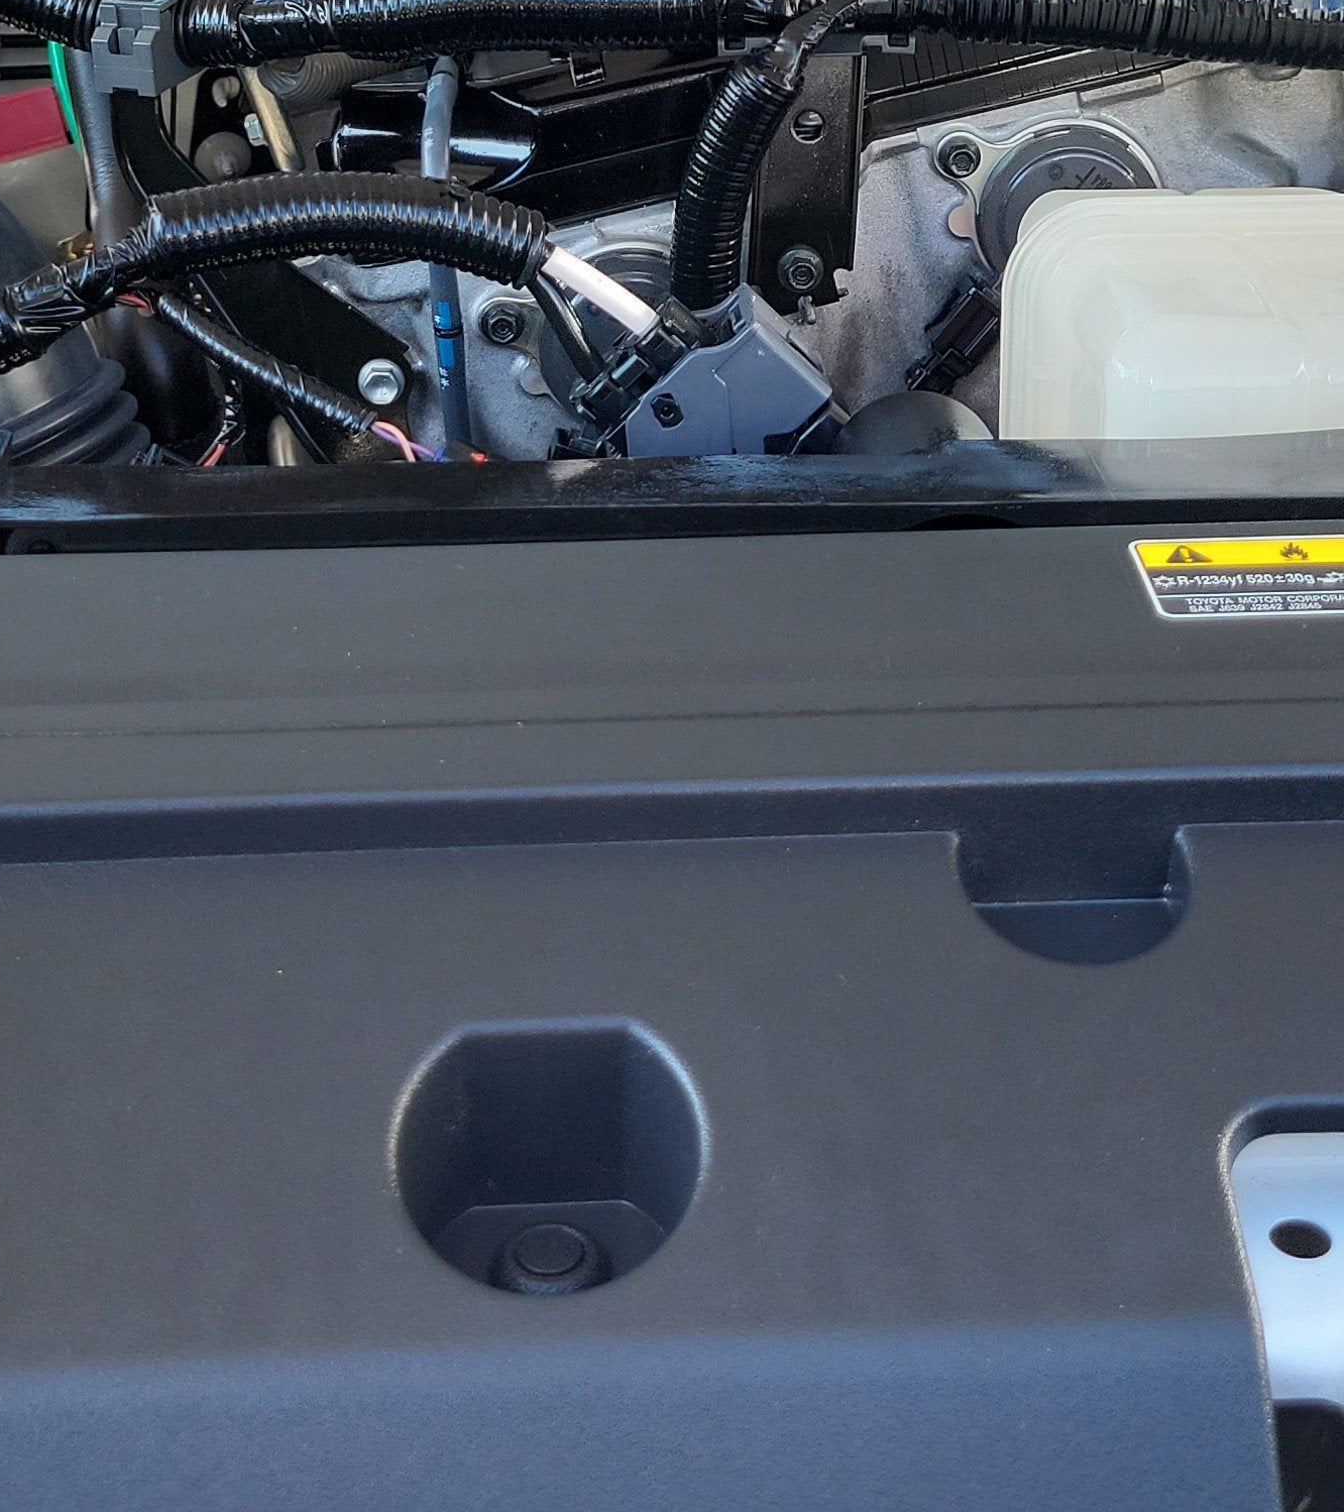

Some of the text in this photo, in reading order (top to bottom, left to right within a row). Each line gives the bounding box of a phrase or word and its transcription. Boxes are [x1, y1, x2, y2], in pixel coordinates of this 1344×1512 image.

[1176, 573, 1244, 589] R-1234yf
[1185, 597, 1234, 605] TOYOTA
[1238, 595, 1283, 604] MOTOR
[1189, 605, 1215, 613] SAE
